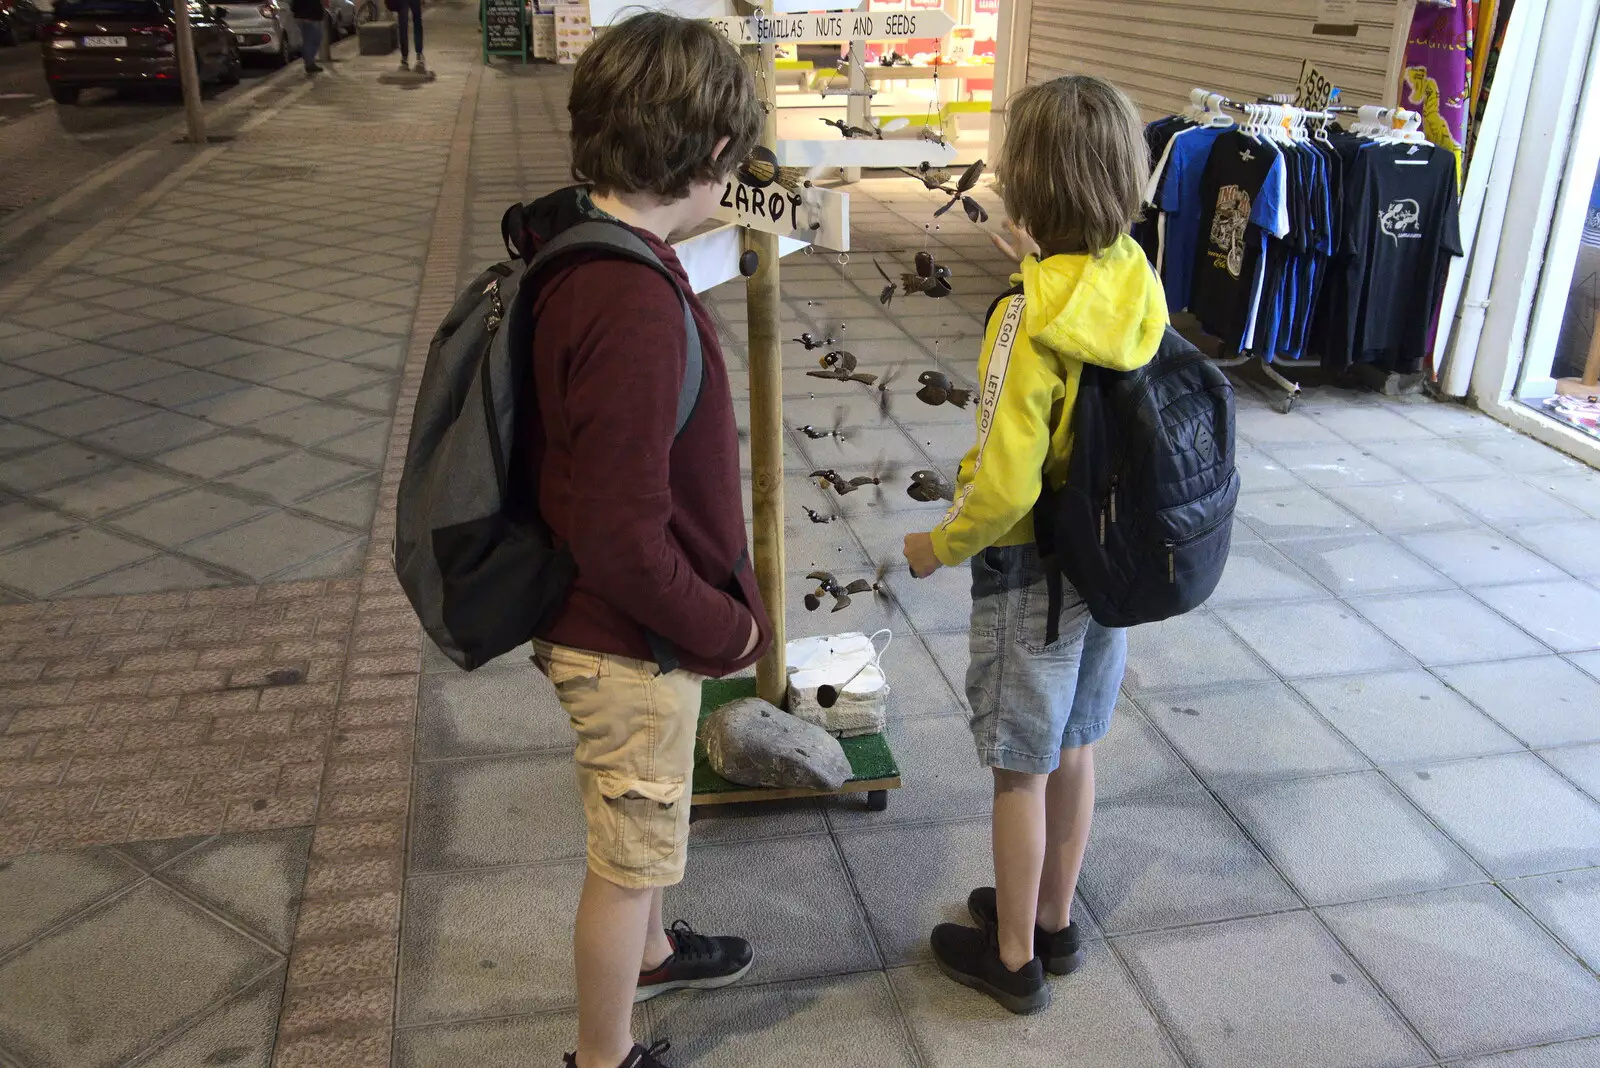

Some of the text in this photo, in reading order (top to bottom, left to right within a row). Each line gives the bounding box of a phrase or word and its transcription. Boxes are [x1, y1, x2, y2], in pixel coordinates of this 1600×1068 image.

[815, 17, 842, 36] NUTS
[852, 15, 873, 36] AND
[885, 14, 916, 35] SEEDS
[998, 292, 1025, 348] ET'S GO!
[979, 374, 1000, 434] LET'S GO!
